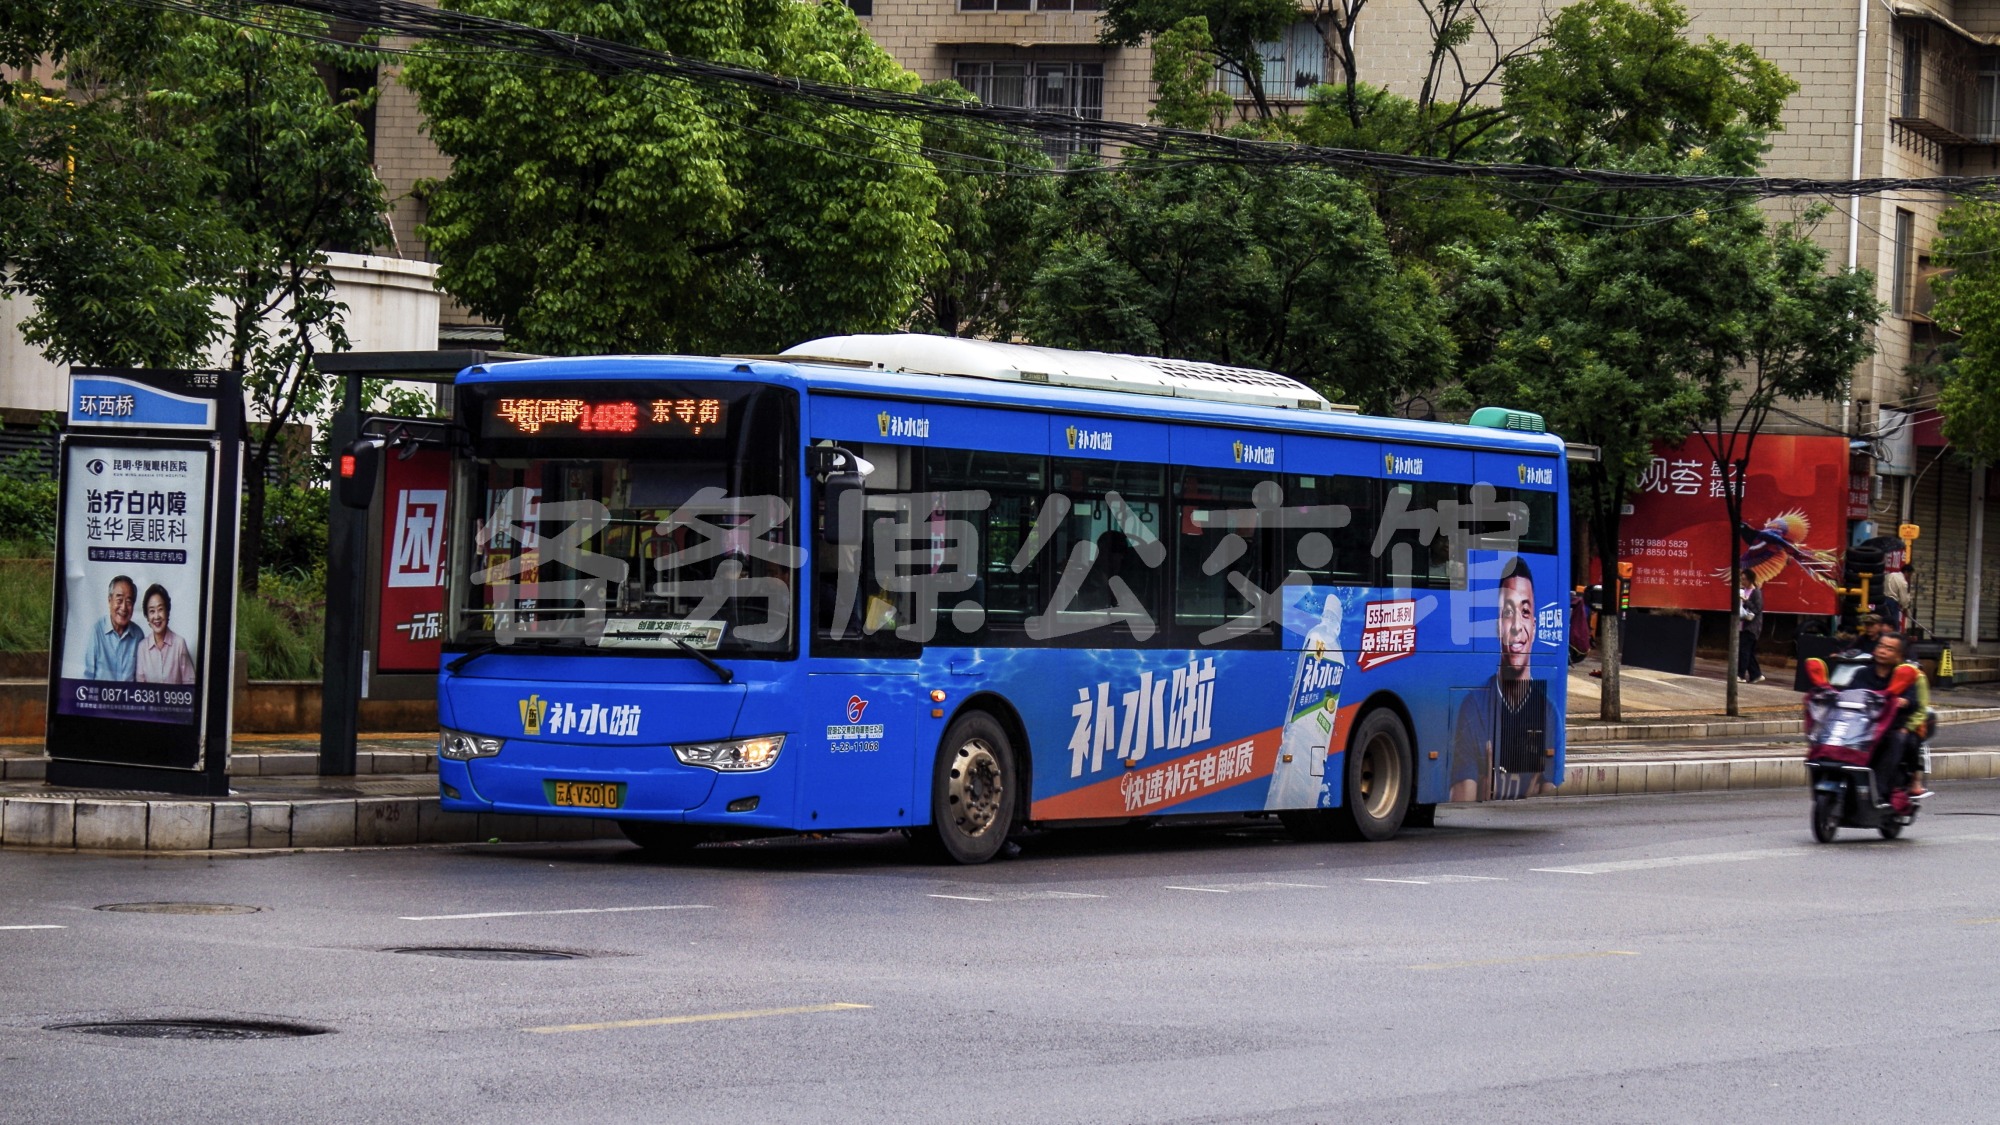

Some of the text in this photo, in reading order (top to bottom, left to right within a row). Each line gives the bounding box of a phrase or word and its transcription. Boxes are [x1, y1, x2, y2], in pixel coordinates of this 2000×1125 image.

[79, 395, 134, 416] 环西桥
[891, 416, 929, 438] 补水啦
[1078, 430, 1112, 451] 补水啦
[1244, 446, 1275, 465] 补水啦
[1395, 457, 1423, 476] 补水啦
[1526, 467, 1553, 485] 补水啦
[87, 489, 187, 516] 治疗白内障
[87, 516, 187, 543] 选华厦眼科
[388, 490, 447, 587] 困
[397, 612, 443, 640] 一元乐
[637, 621, 692, 631] 创建文明城市
[1369, 606, 1411, 625] 555mL系列
[1363, 628, 1416, 653] 免费乐享
[1303, 659, 1344, 693] 补水啦
[101, 687, 160, 703] 0871-6381
[164, 691, 192, 704] 9999
[548, 702, 642, 736] 补水啦
[1067, 657, 1216, 778] 补水啦
[1124, 740, 1254, 812] 快速补充电解质
